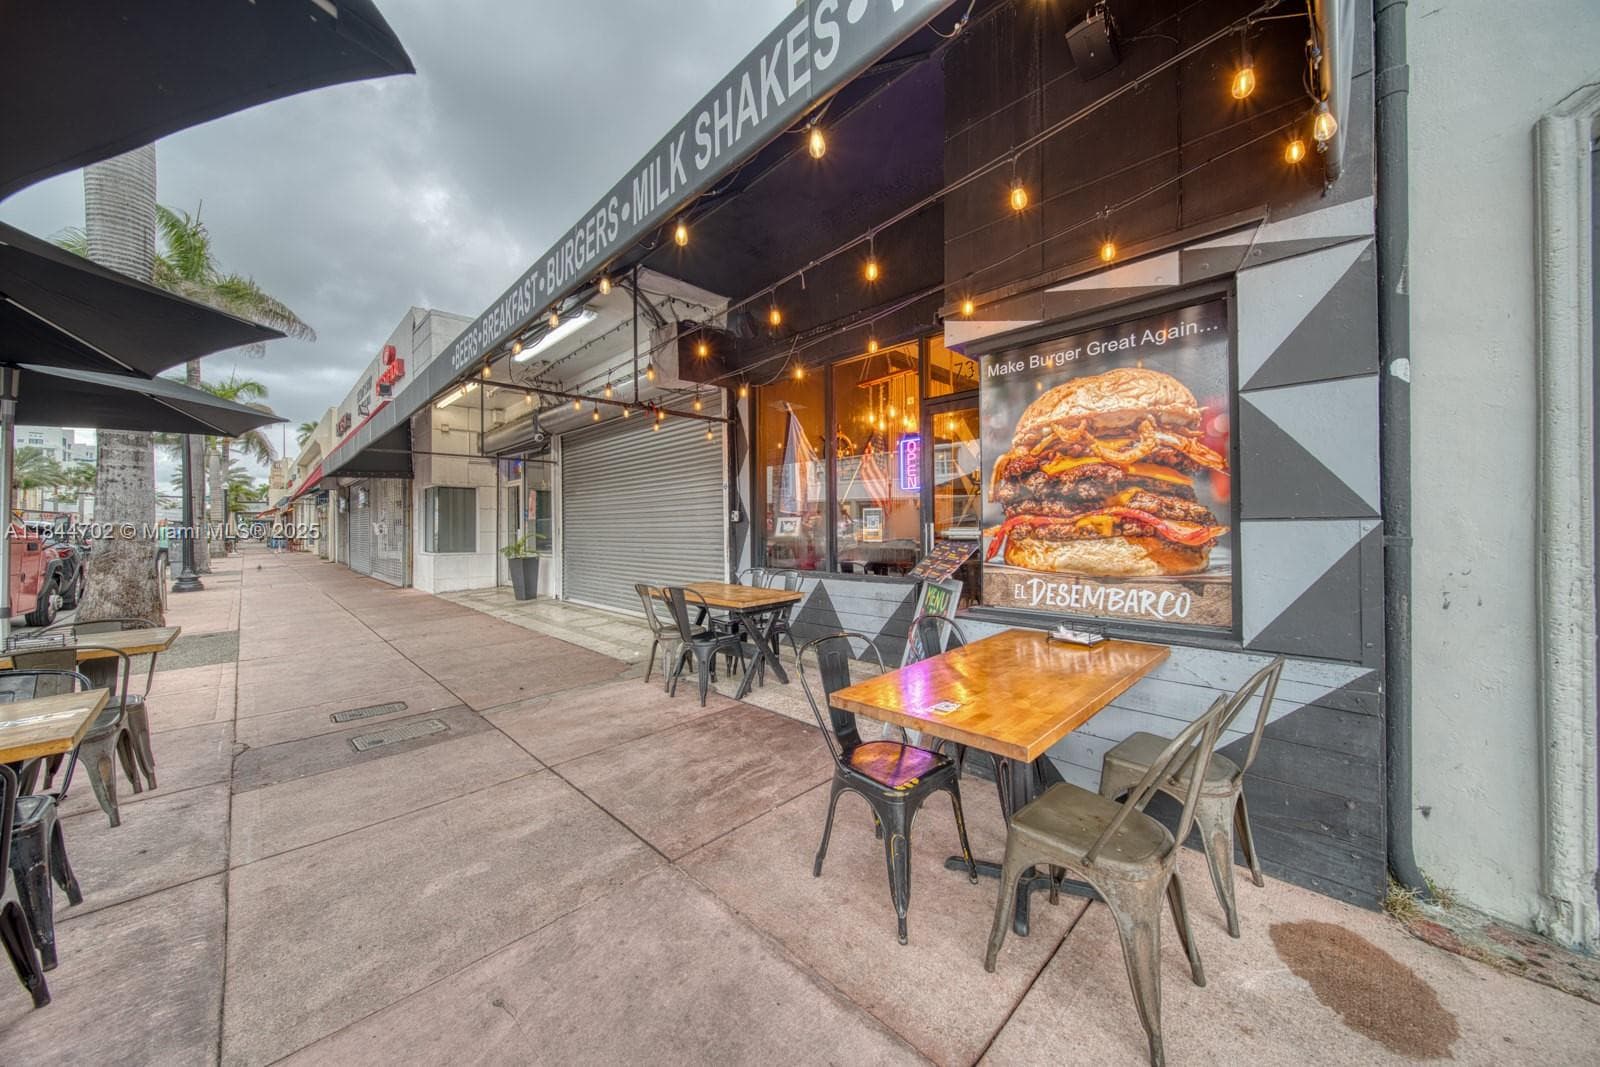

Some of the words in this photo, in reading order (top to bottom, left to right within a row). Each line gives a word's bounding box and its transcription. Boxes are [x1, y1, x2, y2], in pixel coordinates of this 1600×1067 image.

[547, 196, 618, 296] BURGERS
[632, 130, 688, 226] MILK
[694, 0, 841, 171] SHAKES
[987, 360, 1025, 377] Make
[1029, 346, 1082, 369] Burger
[1086, 333, 1136, 357] Great
[907, 440, 917, 489] OPEN
[1014, 583, 1027, 600] EL
[1027, 578, 1191, 620] DESEMBARCO
